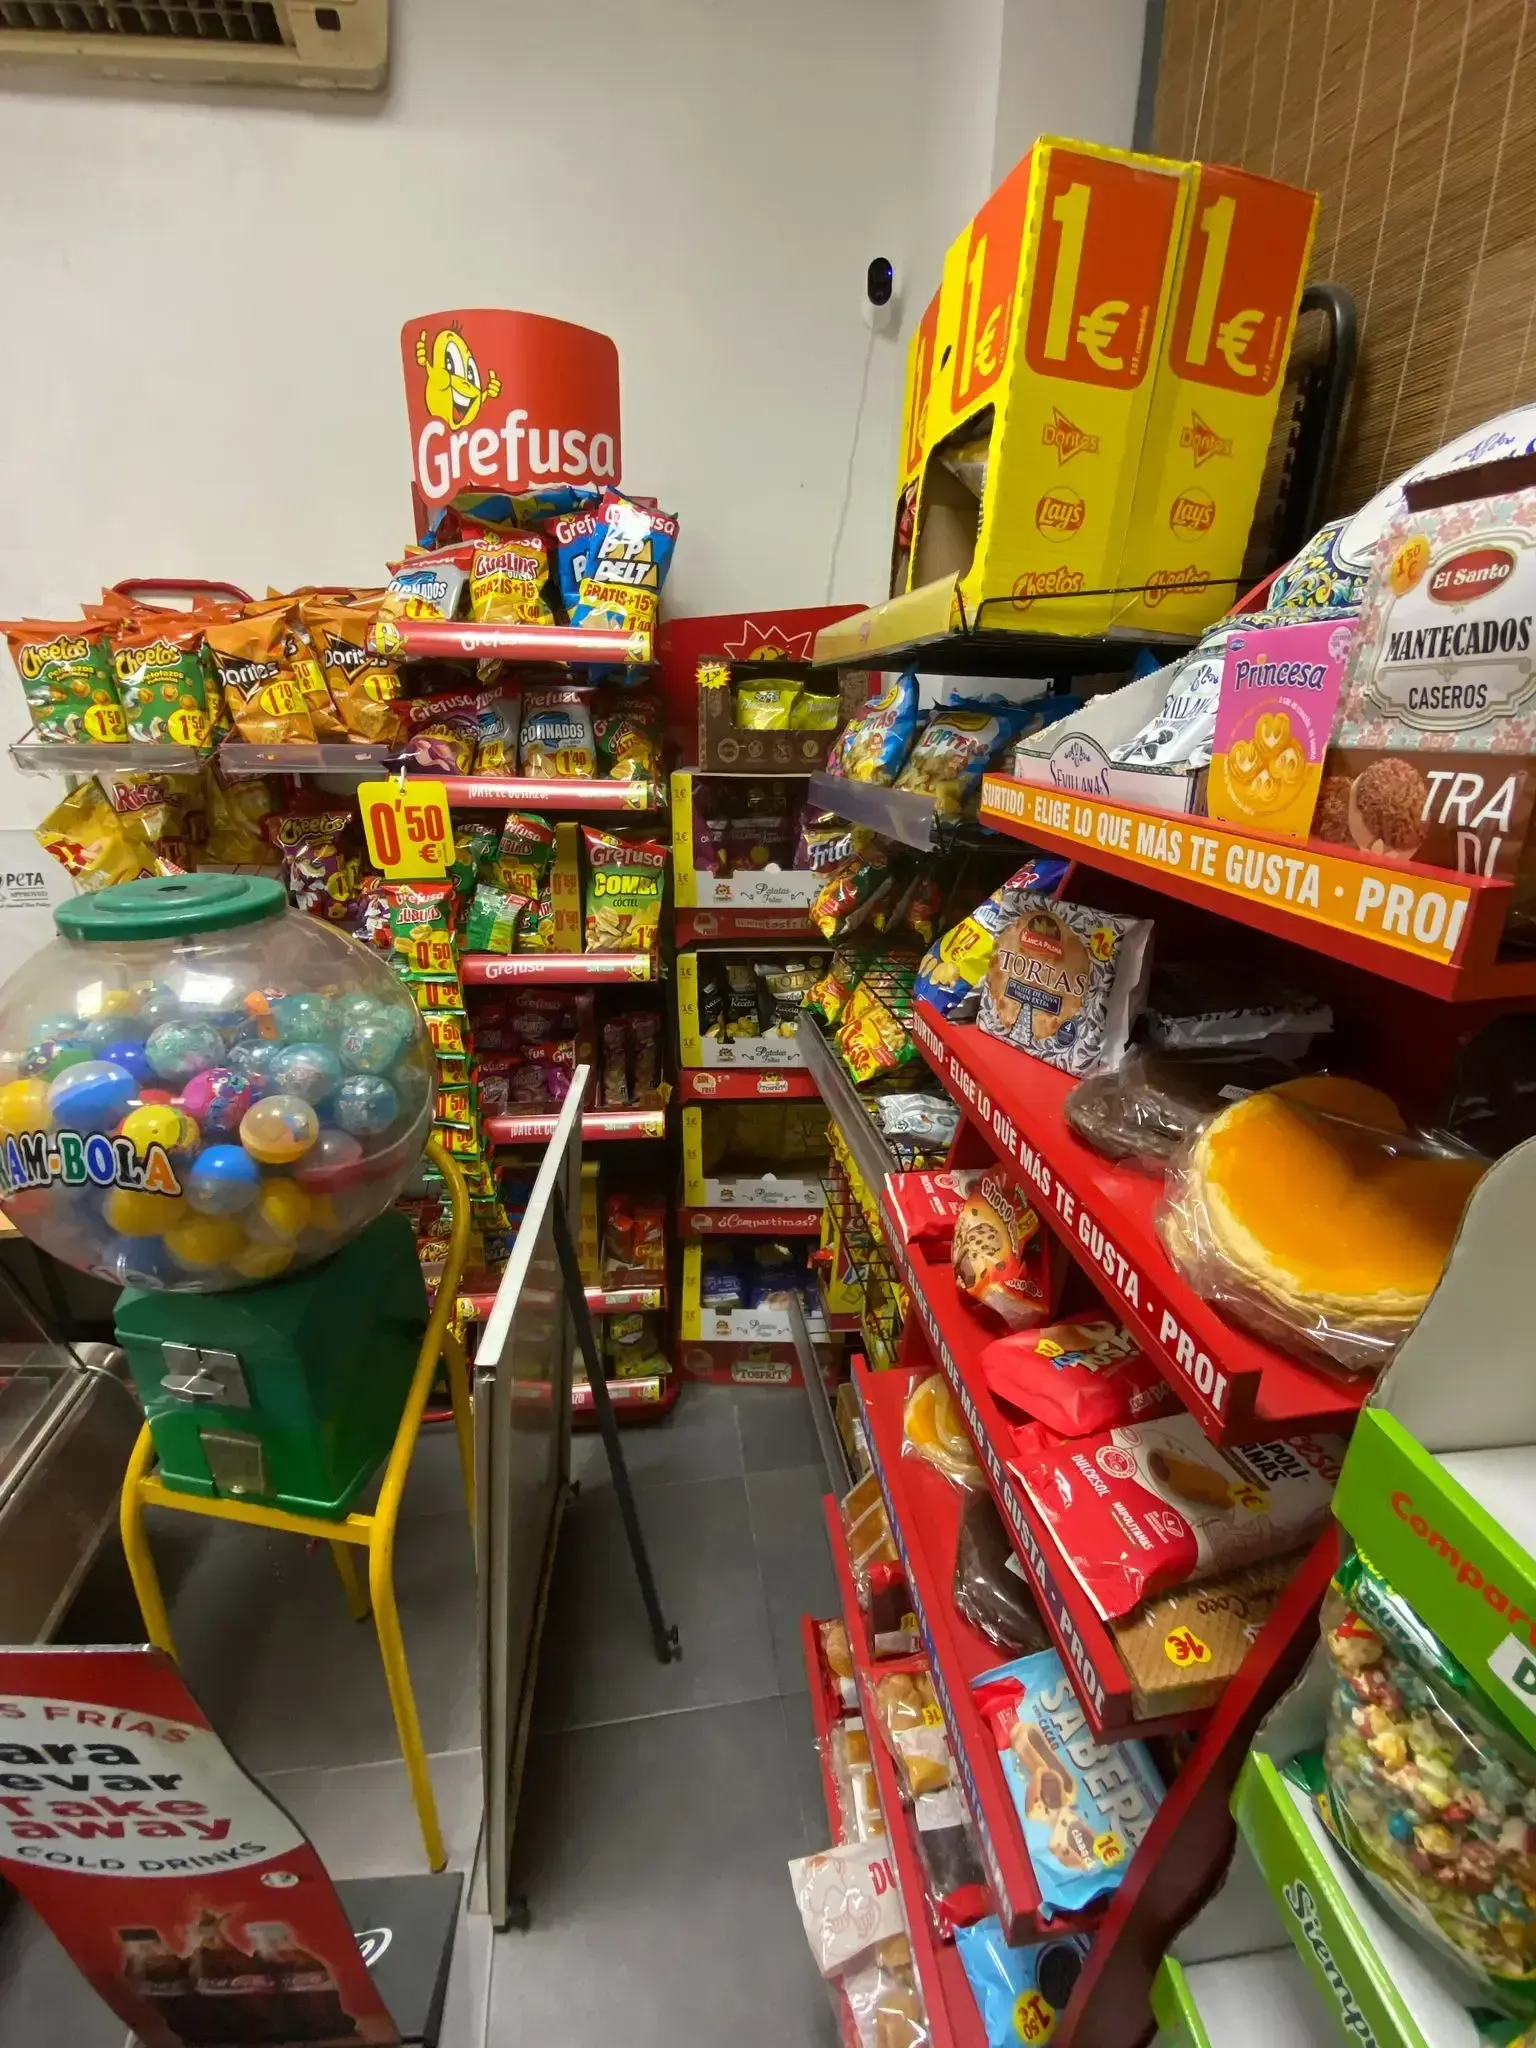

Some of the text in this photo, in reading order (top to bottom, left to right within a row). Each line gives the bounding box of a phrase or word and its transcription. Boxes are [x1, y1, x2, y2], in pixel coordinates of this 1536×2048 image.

[1044, 183, 1130, 371] 1€
[1187, 195, 1266, 376] 1€
[418, 409, 615, 498] Grefusa
[1043, 425, 1099, 453] Doritos
[556, 514, 596, 544] Gref
[1012, 566, 1085, 610] Cheetos
[1433, 563, 1510, 589] El Santo
[21, 637, 89, 679] Cheetos
[1385, 616, 1532, 662] MANTECADOS
[115, 640, 181, 681] Cheetos
[1235, 656, 1327, 691] Princesa
[1409, 684, 1488, 710] CASEROS
[520, 724, 584, 745] CORNADOS
[1421, 771, 1516, 832] TRA
[370, 799, 445, 865] 0'50
[982, 783, 1025, 817] SURTIDO
[1034, 797, 1071, 831] ELIGE
[1074, 807, 1092, 837] LO
[1097, 812, 1133, 850] QUE
[1136, 820, 1182, 866] MÁS
[1191, 835, 1220, 876] TE
[1225, 844, 1320, 909] GUSTA
[591, 845, 664, 867] Grefusa
[594, 872, 658, 897] COMBI
[999, 949, 1089, 997] TORTAS
[913, 1011, 945, 1063] SURTIDO
[950, 1058, 976, 1102] ELIGE
[977, 1086, 991, 1123] LO
[993, 1109, 1016, 1157] QUE
[1019, 1144, 1050, 1196] MÁS
[1055, 1182, 1074, 1226] TE
[1078, 1214, 1140, 1306] GUSTA
[718, 1214, 817, 1228] ¿Compartimos?
[961, 1390, 985, 1448] MÁS
[985, 1440, 1002, 1482] TE
[1002, 1481, 1047, 1587] GUSTA
[43, 1705, 191, 1743] FRÍAS
[7, 1818, 231, 1840] away
[17, 1842, 267, 1871] COLD DRINKS
